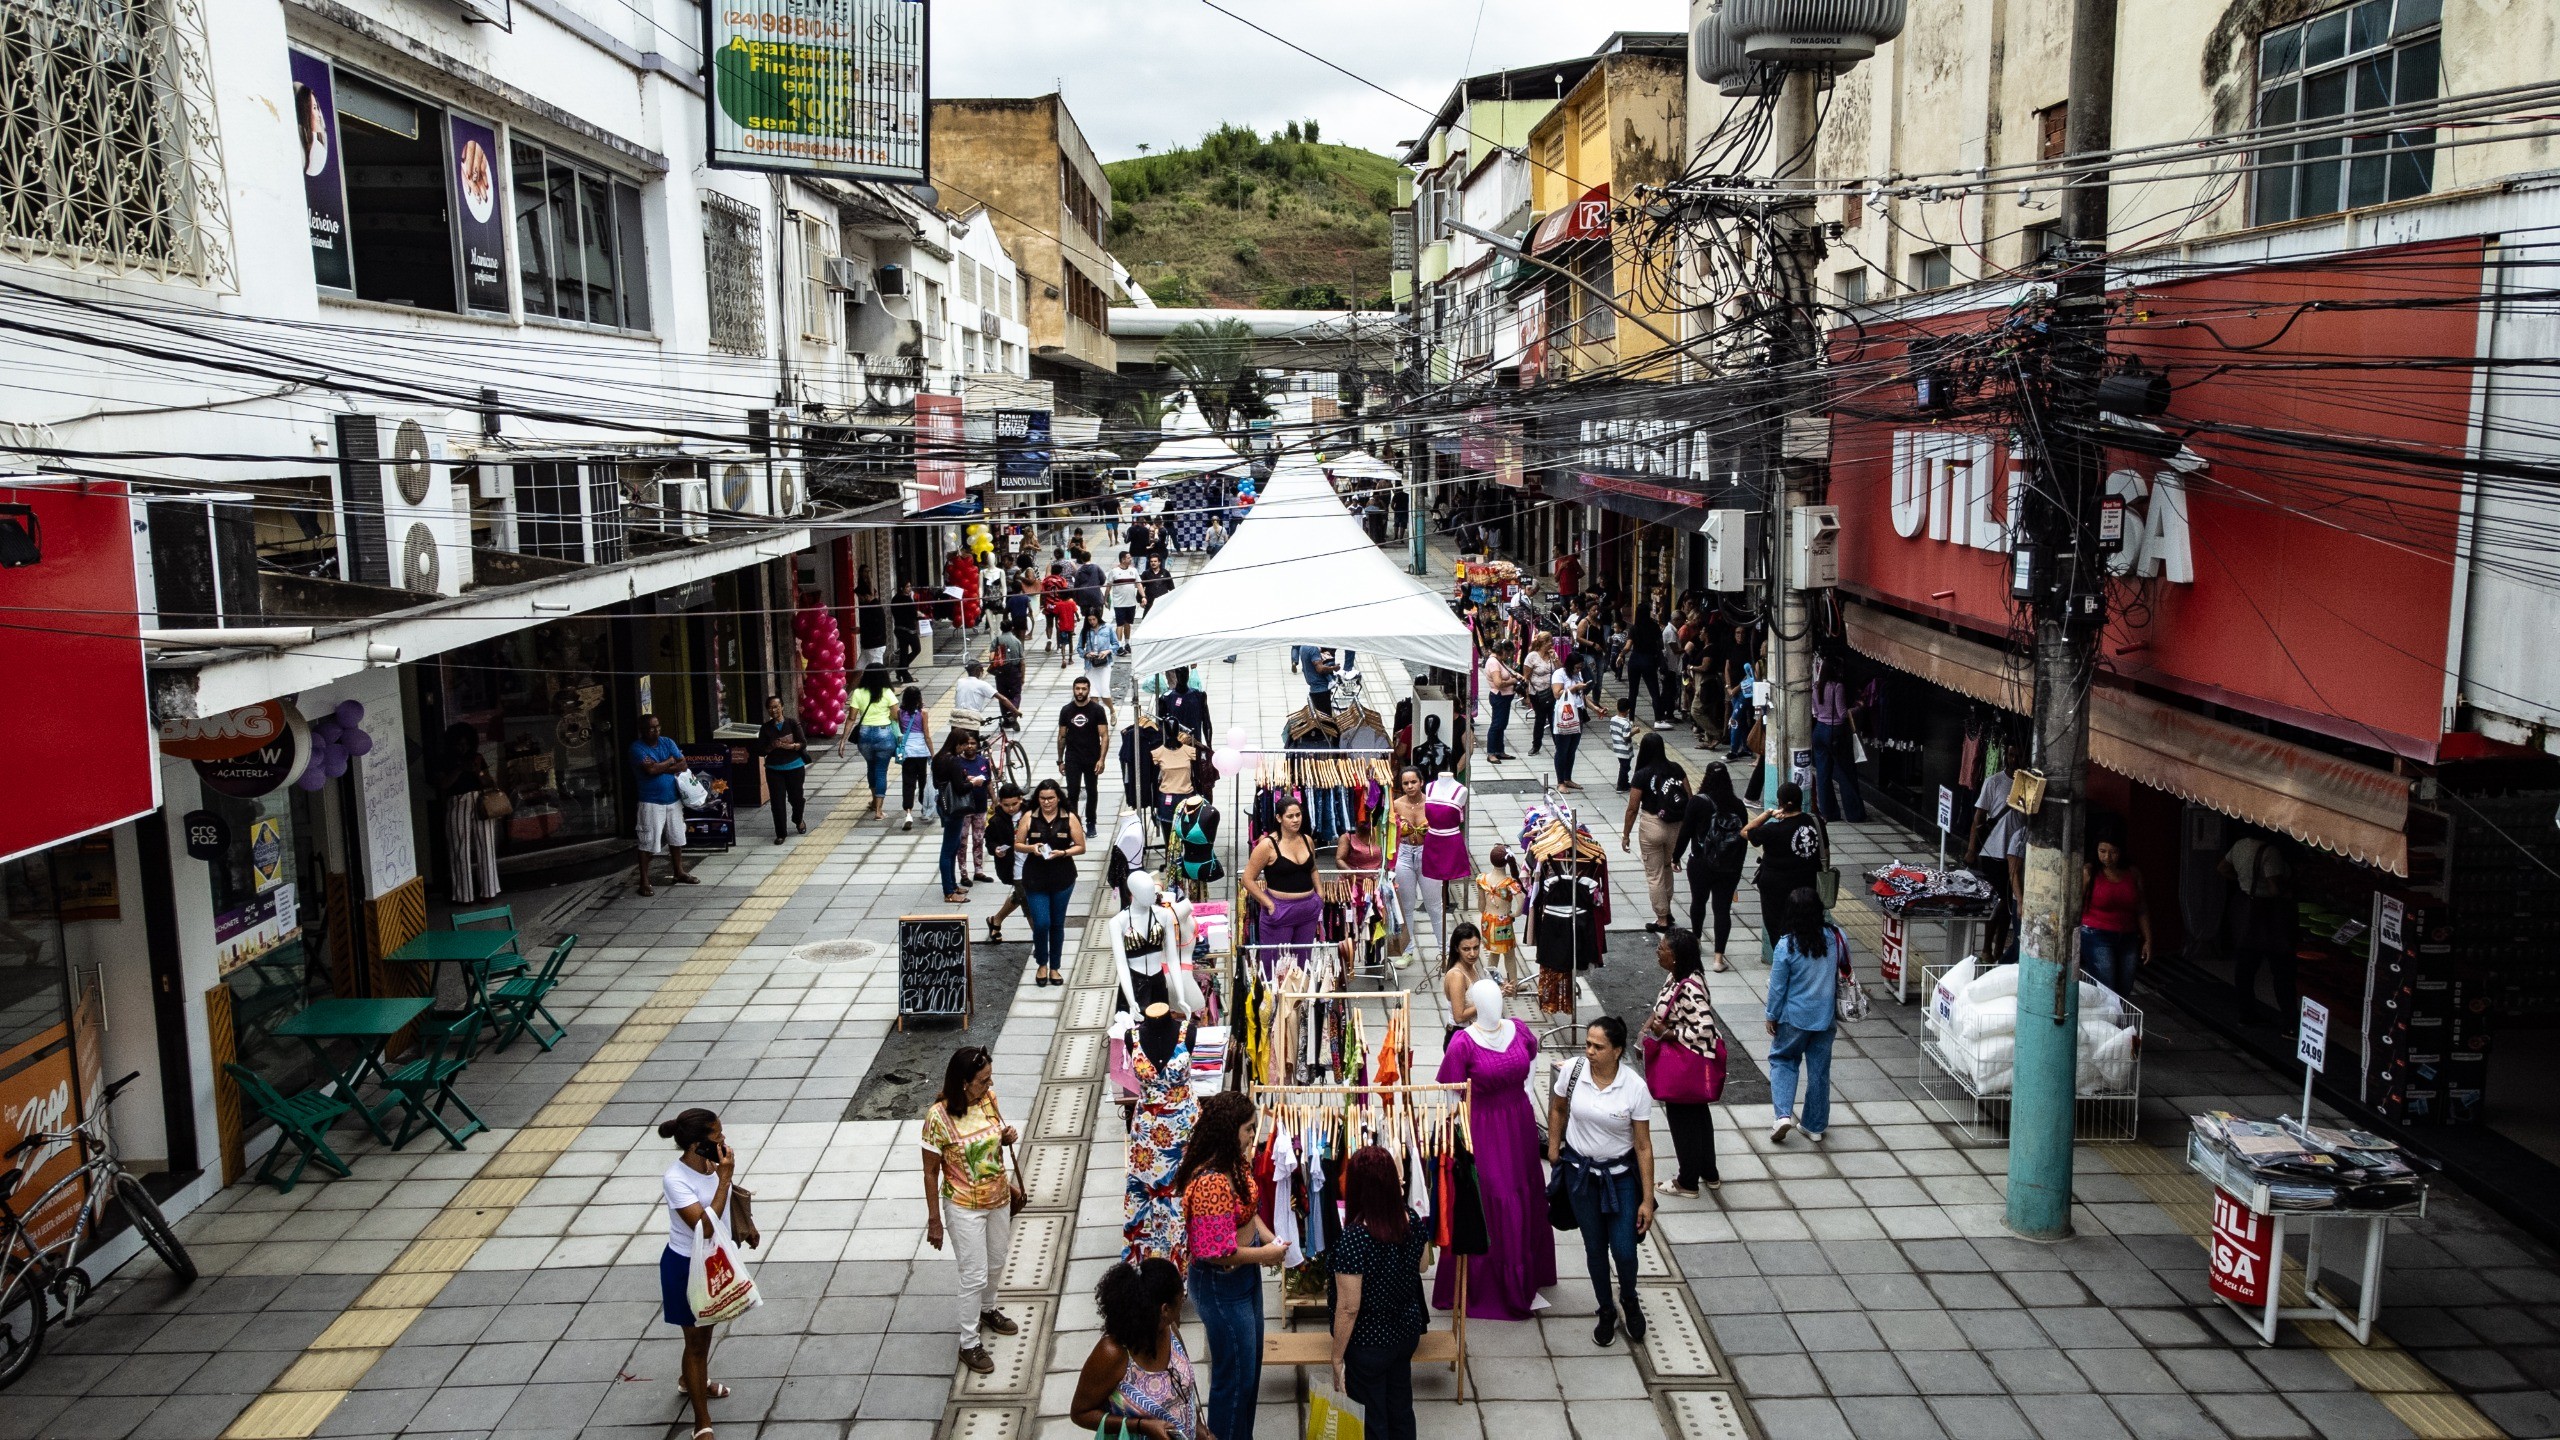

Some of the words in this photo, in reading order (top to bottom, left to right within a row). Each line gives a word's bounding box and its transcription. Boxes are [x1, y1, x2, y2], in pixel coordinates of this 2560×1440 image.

[1002, 477, 1027, 487] BIANCO
[2301, 1040, 2322, 1062] 24,99
[2224, 1279, 2238, 1291] seu
[2239, 1284, 2254, 1297] lar
